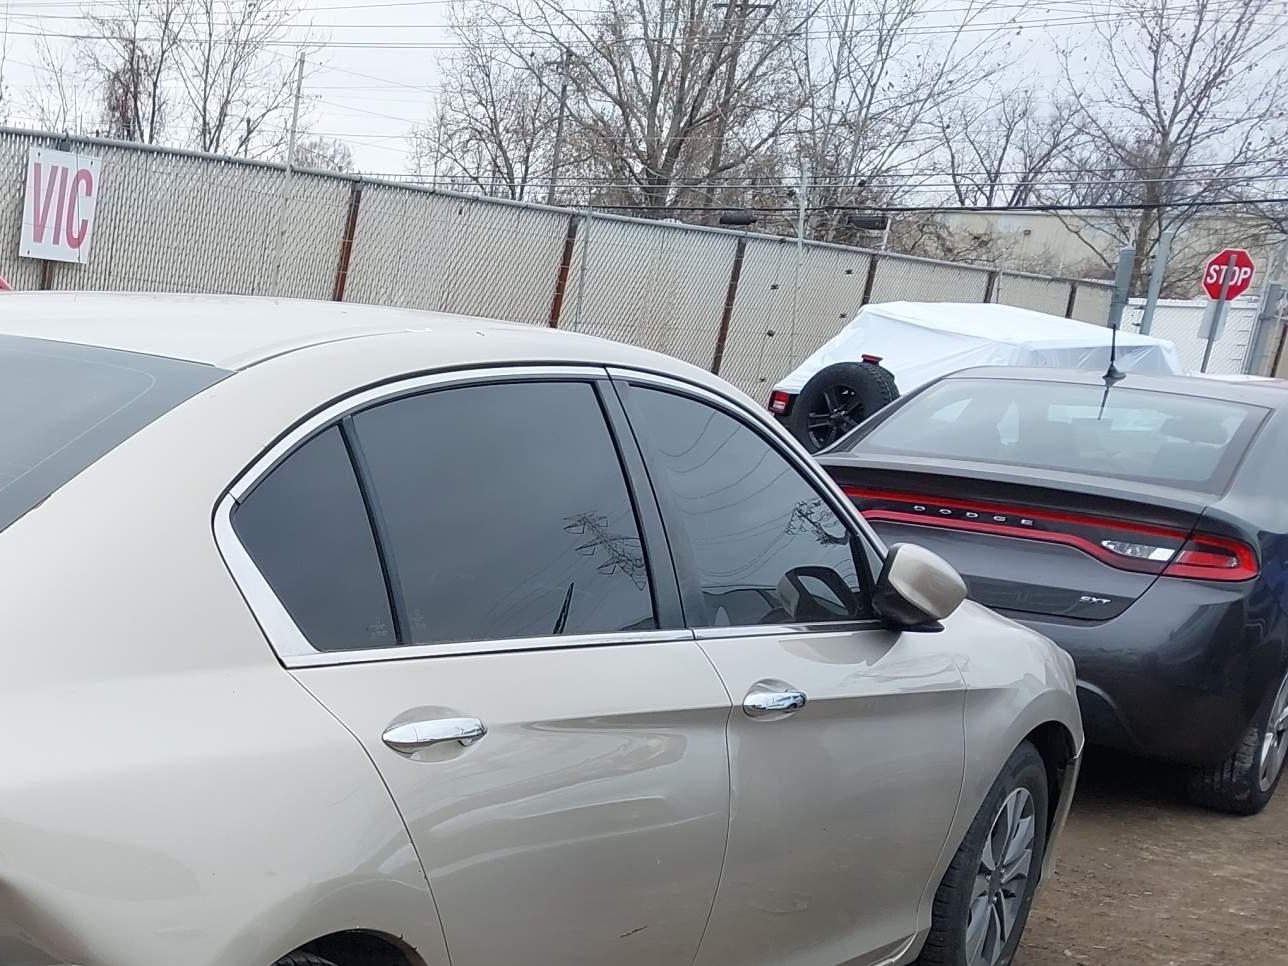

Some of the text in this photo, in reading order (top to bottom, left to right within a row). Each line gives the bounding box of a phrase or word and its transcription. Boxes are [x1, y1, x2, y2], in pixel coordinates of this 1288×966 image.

[33, 162, 94, 249] VIC
[1206, 264, 1252, 286] STOP
[913, 504, 1034, 526] DODGE
